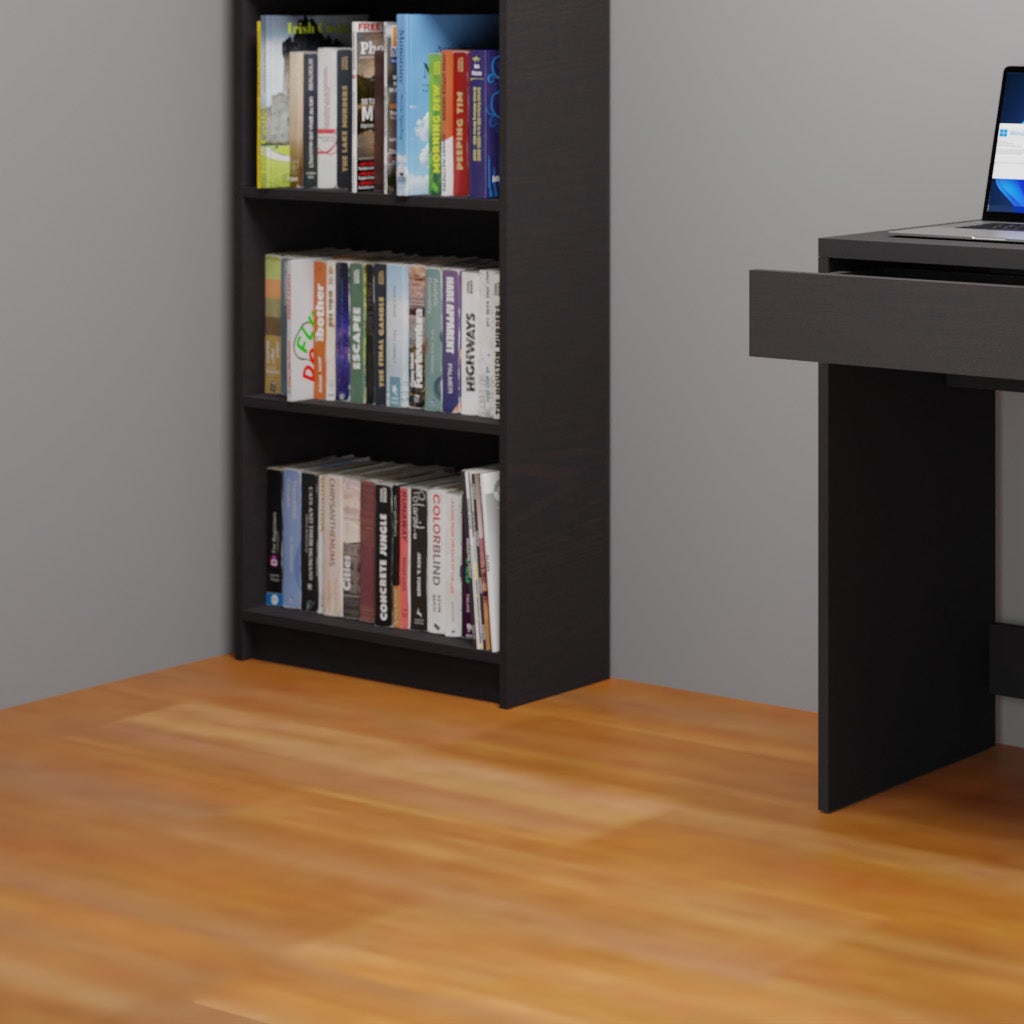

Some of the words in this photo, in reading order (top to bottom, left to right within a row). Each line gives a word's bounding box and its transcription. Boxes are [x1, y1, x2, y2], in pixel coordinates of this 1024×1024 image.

[287, 21, 317, 35] Irish
[358, 22, 381, 31] FREE
[432, 83, 441, 112] DEW
[456, 91, 464, 115] TIM
[432, 114, 441, 174] MORNING
[456, 118, 464, 171] PEEPING
[352, 307, 361, 370] ESCAPEE
[445, 303, 454, 354] APPARENT
[466, 312, 476, 392] HIGHWAYS
[328, 478, 336, 567] CHRYSANTHEMUMS
[379, 513, 388, 557] JUNGLE
[432, 493, 441, 586] COLORBLIND
[379, 558, 388, 622] CONCRETE
